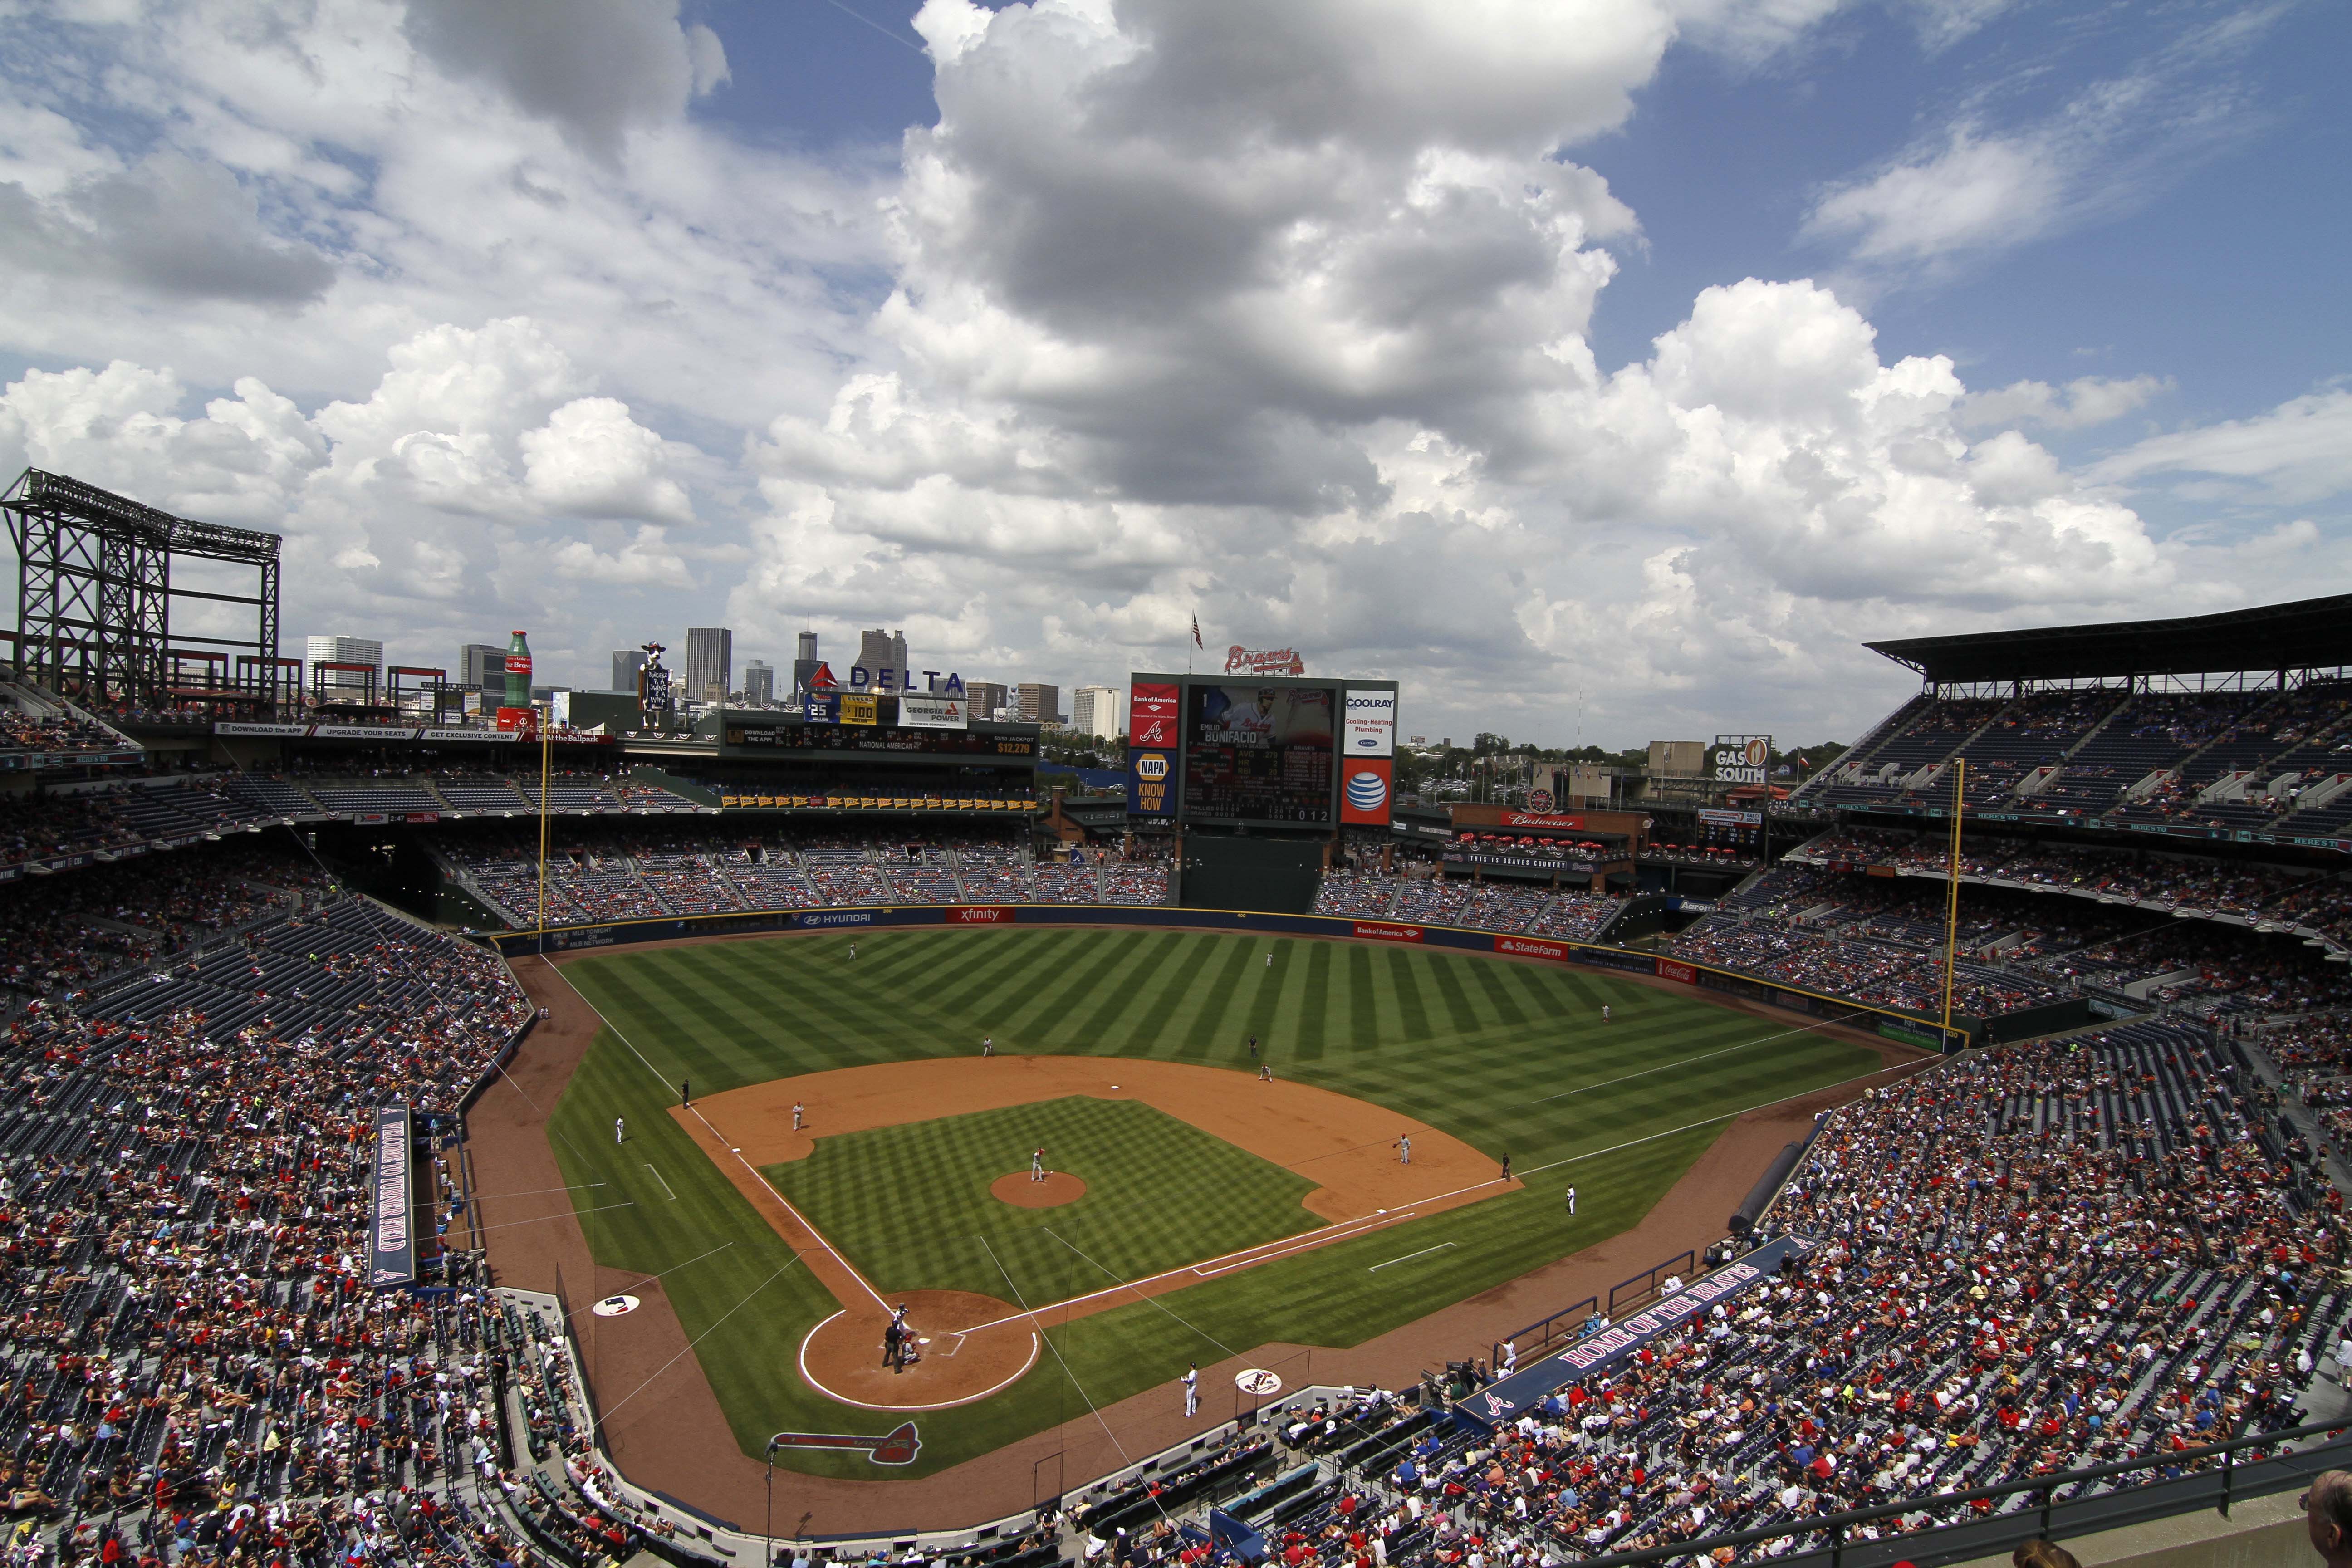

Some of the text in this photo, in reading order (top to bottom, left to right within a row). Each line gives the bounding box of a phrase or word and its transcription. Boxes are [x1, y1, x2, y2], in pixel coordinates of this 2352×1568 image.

[1224, 645, 1293, 672] Braves
[851, 666, 963, 692] DELTA
[1203, 693, 1207, 708] 1
[1346, 698, 1394, 708] COOLRAY
[232, 725, 273, 734] DOWNLOAD
[568, 735, 598, 743] Ballpark
[1205, 731, 1257, 744] BONIFACIO
[886, 742, 913, 750] AMERICAN
[997, 742, 1030, 754] $12,279
[1715, 751, 1746, 766] GAS
[1142, 761, 1164, 774] NAPA
[1715, 767, 1766, 784] SOUTH
[1138, 783, 1166, 798] KNOW
[1140, 797, 1162, 811] HOW
[1299, 810, 1305, 820] 0
[1311, 811, 1316, 820] 1
[1321, 811, 1327, 821] 2
[1508, 814, 1575, 828] Budweiser
[1503, 857, 1529, 866] BRAVES
[1534, 859, 1566, 869] COUNTRY
[1679, 900, 1715, 913] Aaron's
[823, 913, 871, 923] HYUNDAI
[961, 908, 1000, 922] xfinity
[1378, 928, 1403, 937] America
[584, 938, 614, 946] NETWORK
[1946, 1030, 1958, 1039] 330
[378, 1120, 407, 1252] WELCOME TO TURNER FIELD
[1557, 1262, 1760, 1369] HOME OF THE BRAVES
